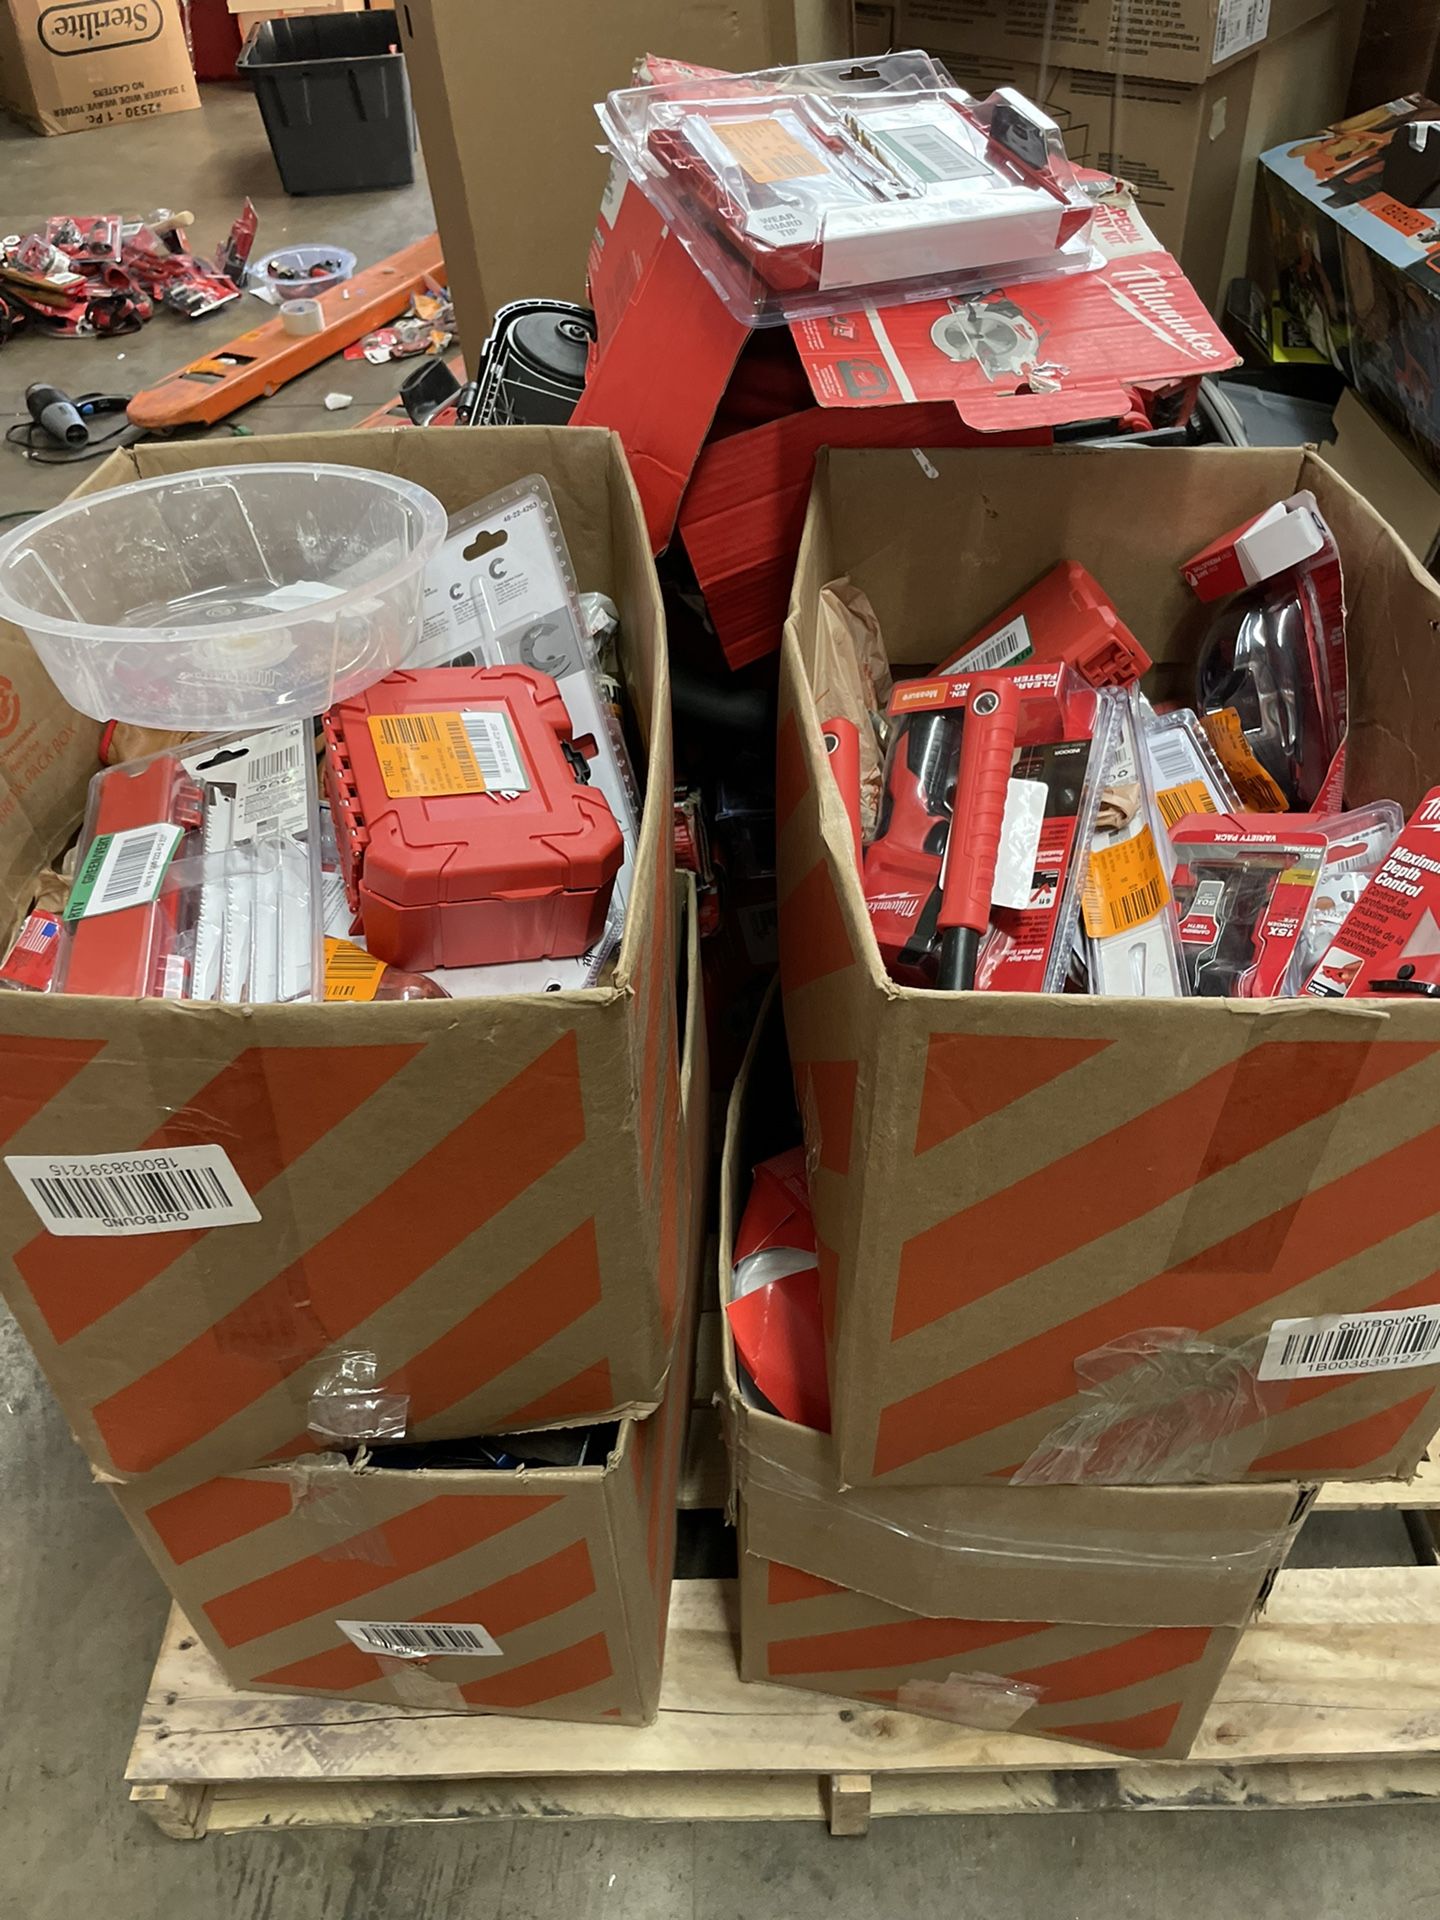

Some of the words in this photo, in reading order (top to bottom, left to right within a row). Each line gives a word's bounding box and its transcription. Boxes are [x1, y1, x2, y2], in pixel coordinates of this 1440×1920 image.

[53, 3, 149, 41] Sterilite
[92, 86, 130, 97] CASTERS
[759, 213, 796, 225] WEAR
[763, 219, 803, 232] GUARD
[778, 228, 798, 238] TIP
[1111, 263, 1221, 360] Milwaukee
[1013, 673, 1059, 683] FASTER
[1018, 680, 1058, 691] CLEAR.
[902, 688, 939, 701] Measure
[1213, 833, 1239, 842] PACK
[1239, 834, 1277, 842] VARIETY
[67, 901, 85, 919] RTV
[81, 836, 112, 885] GREEN/VERT
[1382, 860, 1422, 882] Depth
[1374, 872, 1424, 898] Control
[1367, 886, 1398, 902] Control
[1397, 896, 1409, 908] de
[866, 899, 919, 918] Milwauke
[1359, 894, 1412, 921] profundidad
[1266, 920, 1298, 929] LONGER
[1266, 927, 1294, 938] 15X
[1341, 926, 1389, 950] profondeur
[1382, 929, 1395, 940] de
[1337, 935, 1377, 958] maximale
[48, 1156, 179, 1177] 1B0038391215
[102, 1211, 190, 1229] OUTBOUND
[1338, 1313, 1428, 1331] OUTBOUND
[1306, 1350, 1432, 1373] 1B0038391277
